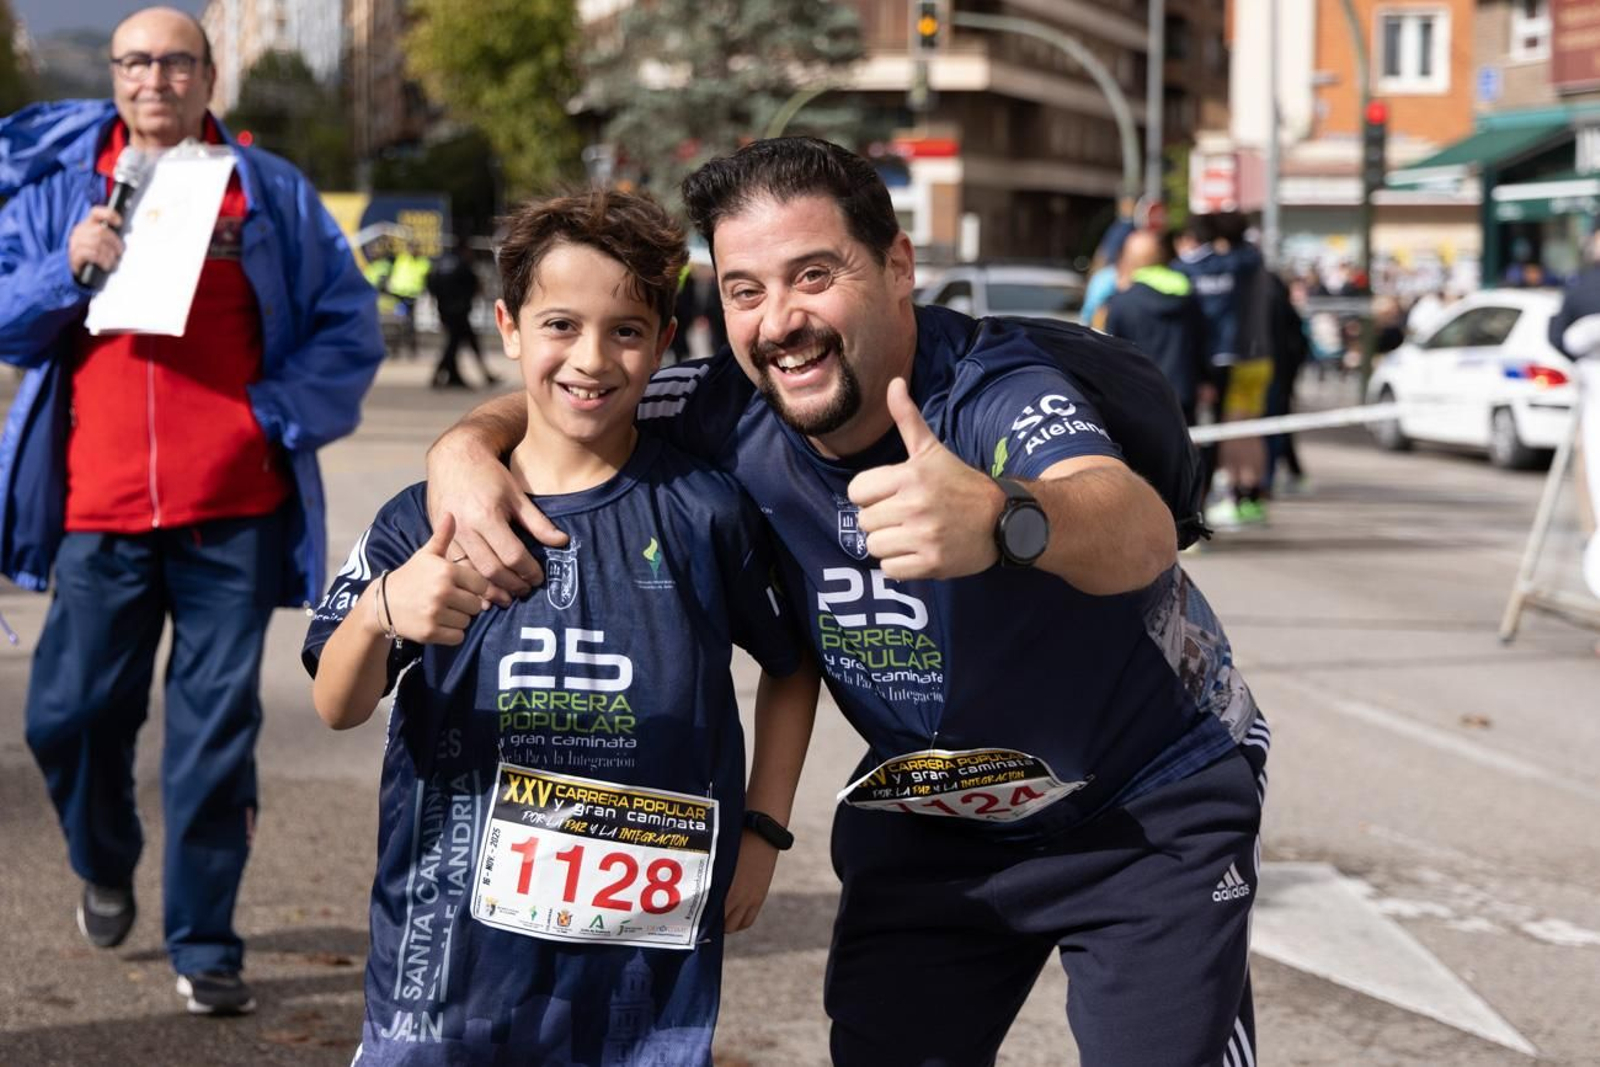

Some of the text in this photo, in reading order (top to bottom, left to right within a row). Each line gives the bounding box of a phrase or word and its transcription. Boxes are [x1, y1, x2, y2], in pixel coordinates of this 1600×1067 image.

[1025, 417, 1112, 455] Alejan
[817, 567, 929, 630] 25
[818, 613, 936, 650] CRRERA
[498, 627, 633, 692] 25
[823, 653, 835, 666] y
[840, 657, 867, 672] gra
[497, 690, 633, 714] CARRERA
[500, 712, 636, 736] POPULAR
[510, 734, 545, 746] gran
[551, 735, 638, 749] caminata
[888, 757, 956, 772] CARRERA
[911, 770, 949, 783] gran
[958, 759, 1034, 776] caminata
[503, 774, 706, 820] XXV CARRERA POPULAR
[895, 786, 911, 797] LA
[521, 810, 545, 824] POR
[546, 815, 565, 828] LA
[564, 819, 588, 833] PAZ
[599, 824, 618, 838] LA
[553, 797, 706, 831] y gran caminata
[482, 877, 491, 886] 16
[490, 827, 501, 849] 2025
[510, 836, 684, 915] 1128
[1212, 884, 1250, 902] adidas
[402, 913, 436, 1000] SANTA
